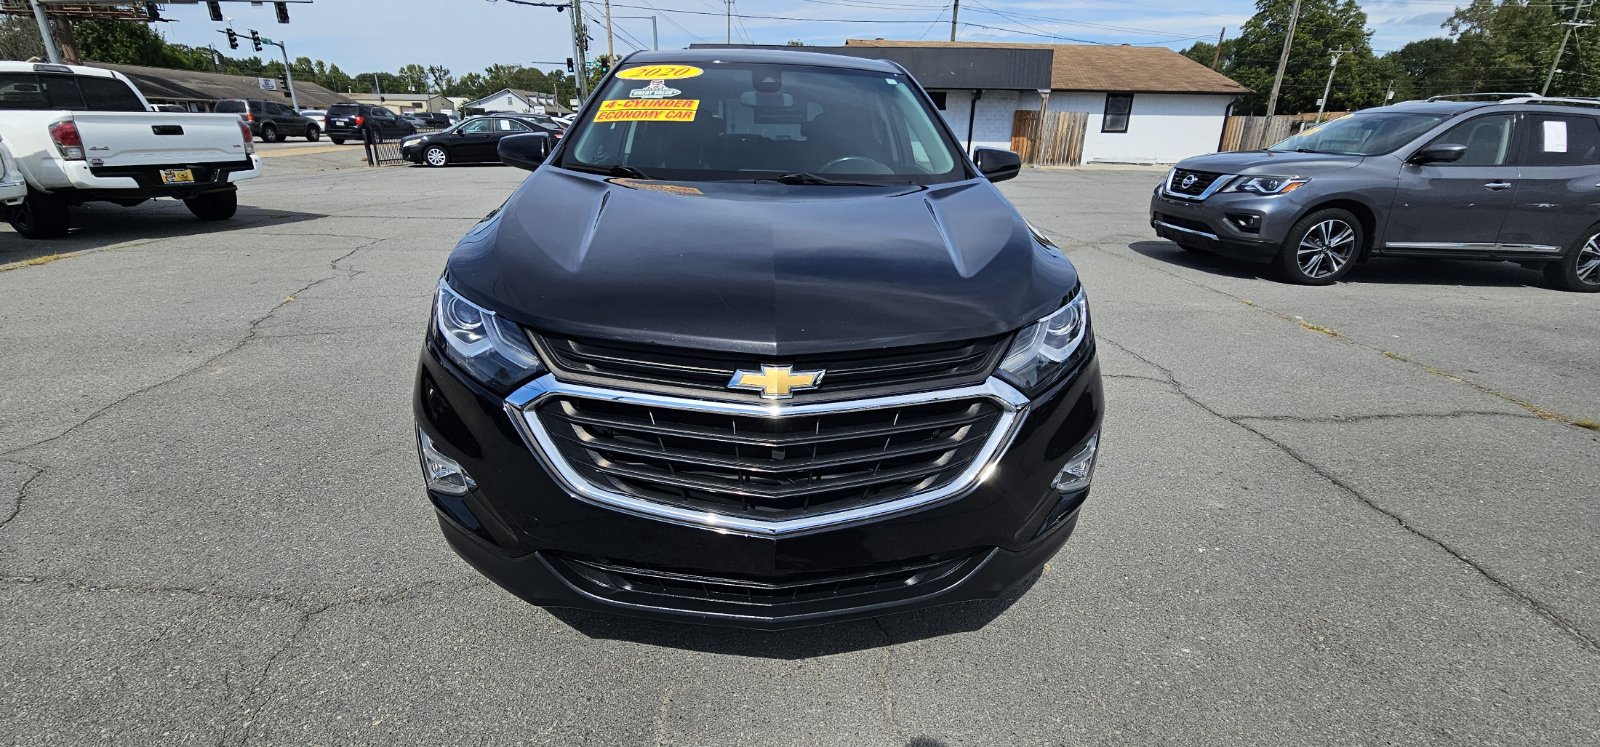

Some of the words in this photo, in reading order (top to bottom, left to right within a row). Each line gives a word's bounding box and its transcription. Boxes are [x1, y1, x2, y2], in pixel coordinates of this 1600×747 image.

[631, 67, 691, 77] 2020
[597, 110, 662, 120] ECONOMY
[665, 110, 693, 119] CAR
